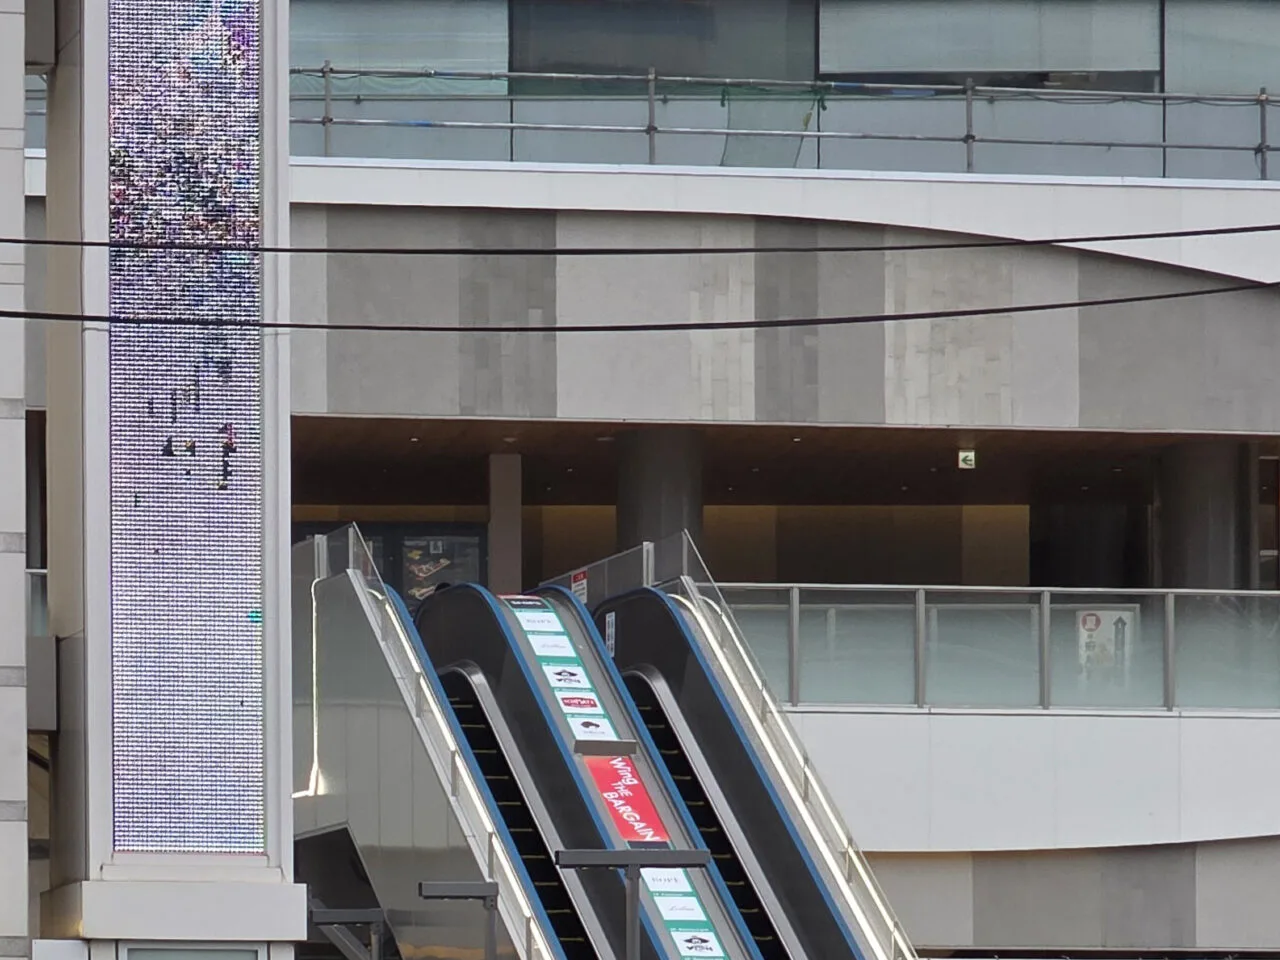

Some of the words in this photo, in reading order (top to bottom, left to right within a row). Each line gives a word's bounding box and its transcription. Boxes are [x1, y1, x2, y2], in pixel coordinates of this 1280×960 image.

[609, 755, 639, 785] Wing
[611, 781, 633, 797] THE
[602, 791, 662, 841] BARGAIN
